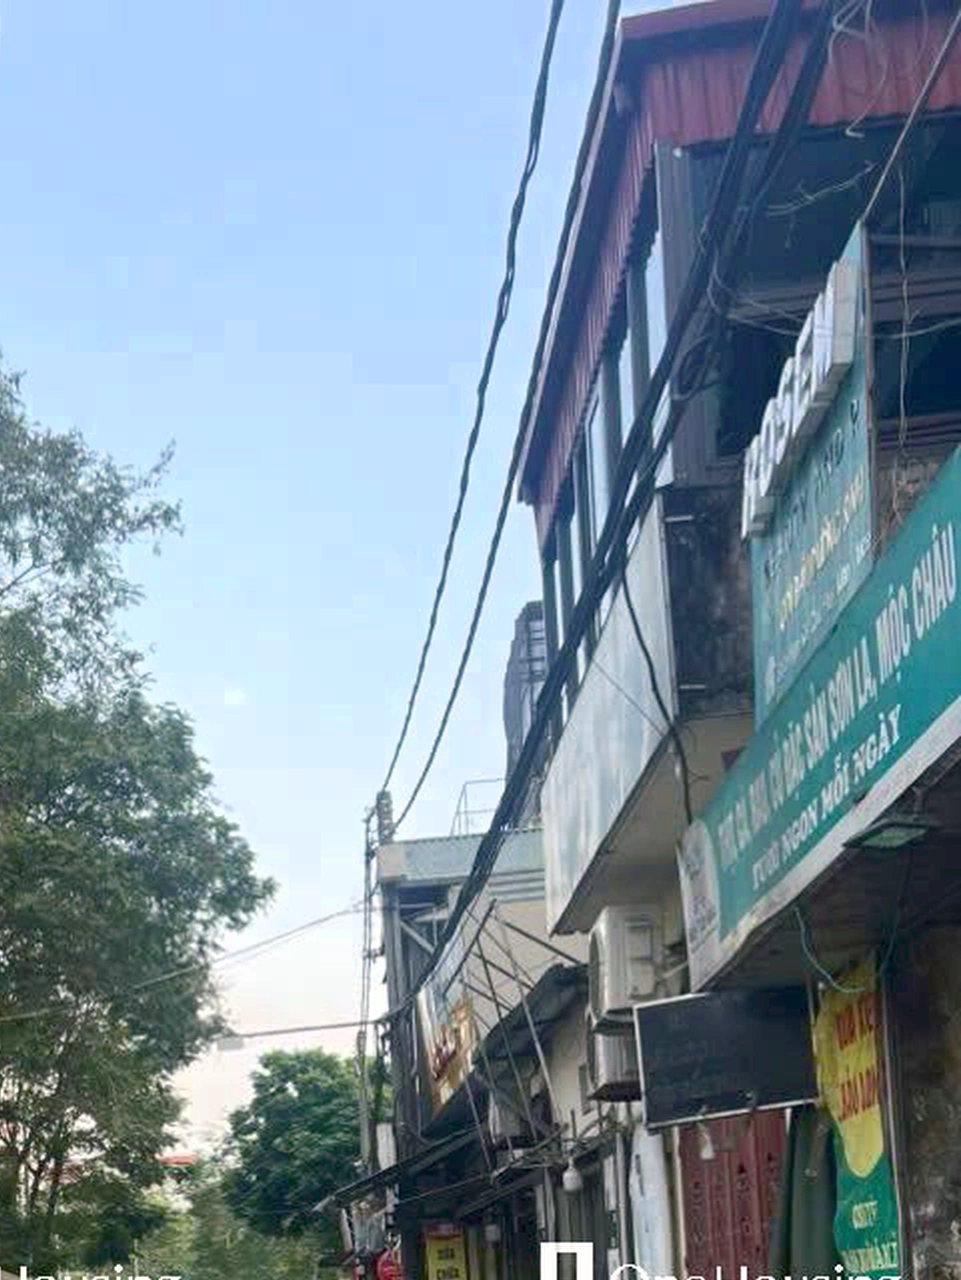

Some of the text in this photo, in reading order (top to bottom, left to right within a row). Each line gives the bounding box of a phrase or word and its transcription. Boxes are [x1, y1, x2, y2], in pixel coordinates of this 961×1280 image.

[876, 583, 911, 684] MỘC
[911, 523, 958, 639] CHÂU
[820, 751, 851, 823] MỖI
[852, 703, 902, 786] NGÀY
